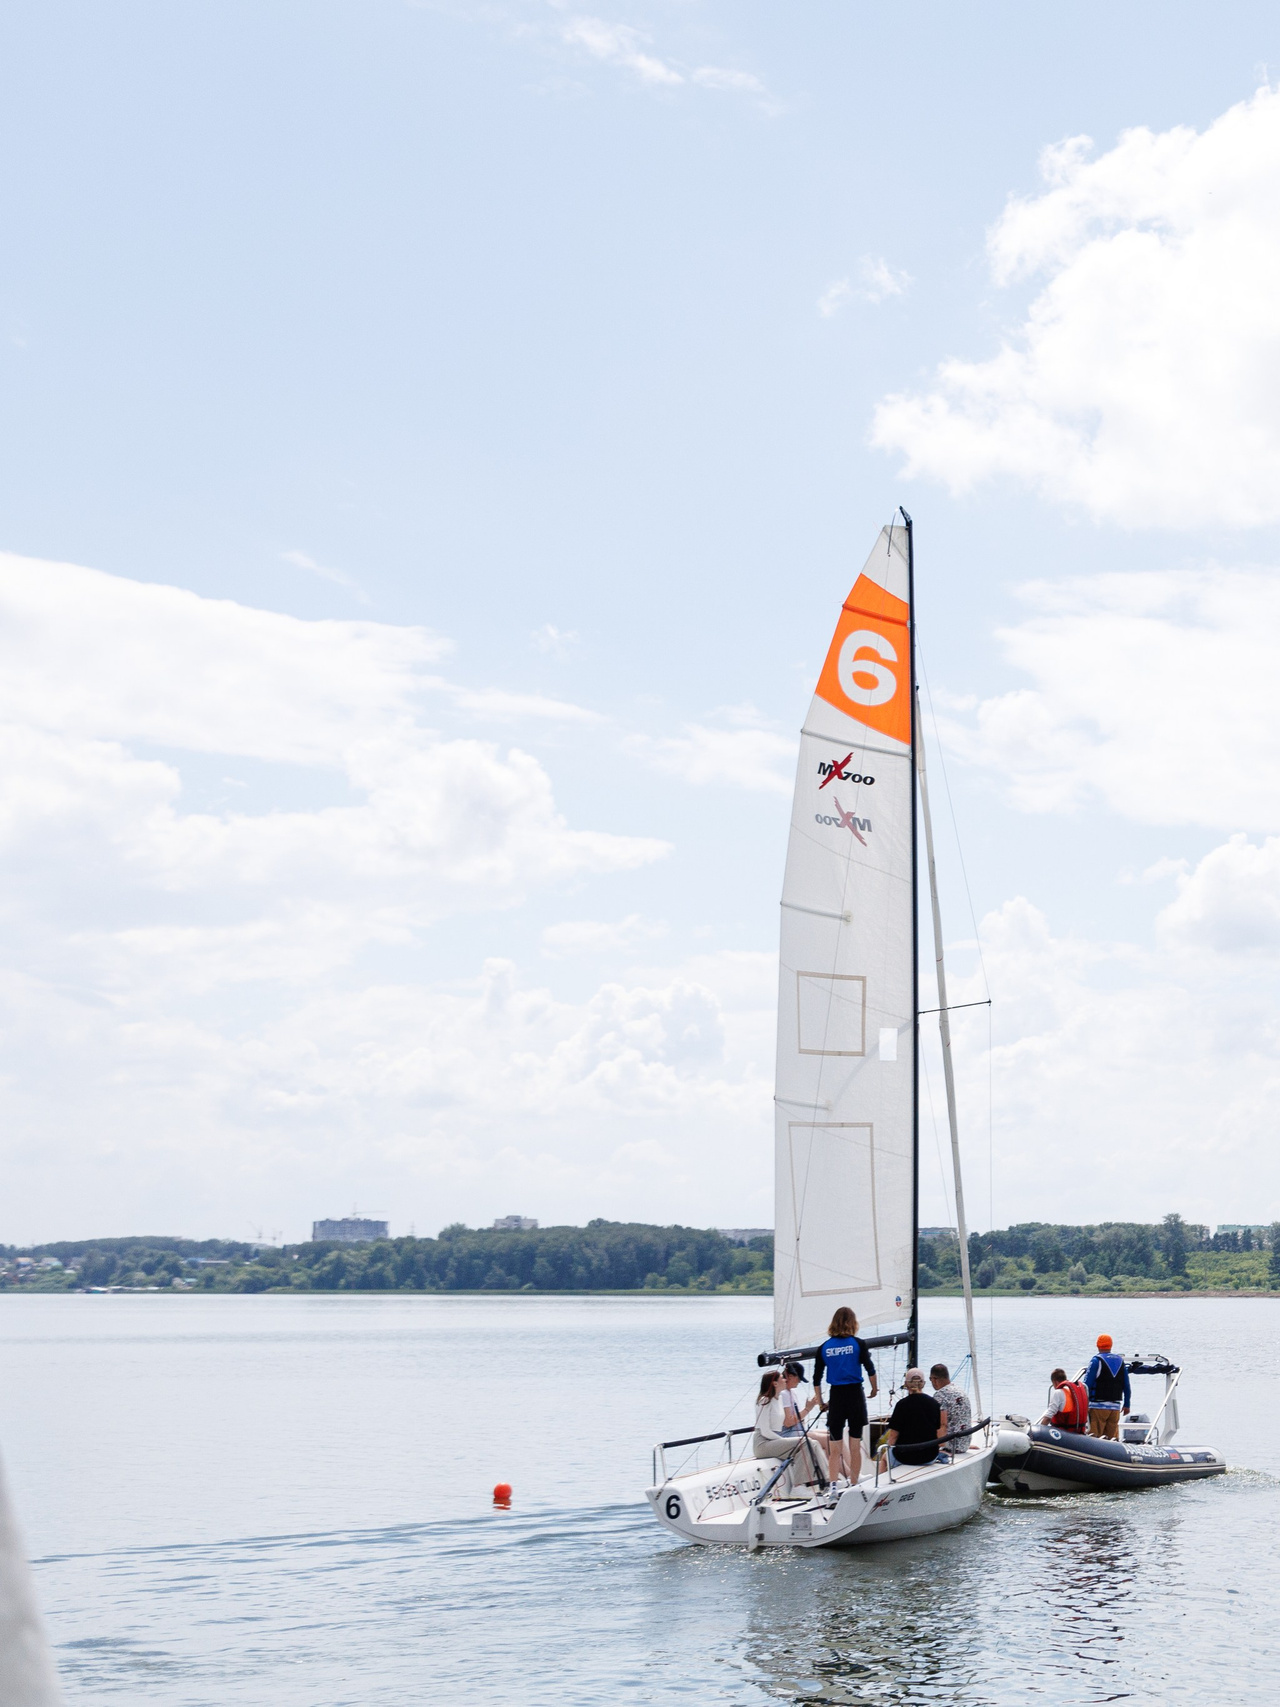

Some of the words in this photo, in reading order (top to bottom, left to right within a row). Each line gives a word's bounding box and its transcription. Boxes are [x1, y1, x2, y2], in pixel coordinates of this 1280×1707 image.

[838, 629, 898, 707] 6
[817, 752, 876, 790] MX700
[826, 1345, 854, 1357] SKIPPER
[666, 1494, 681, 1520] 6
